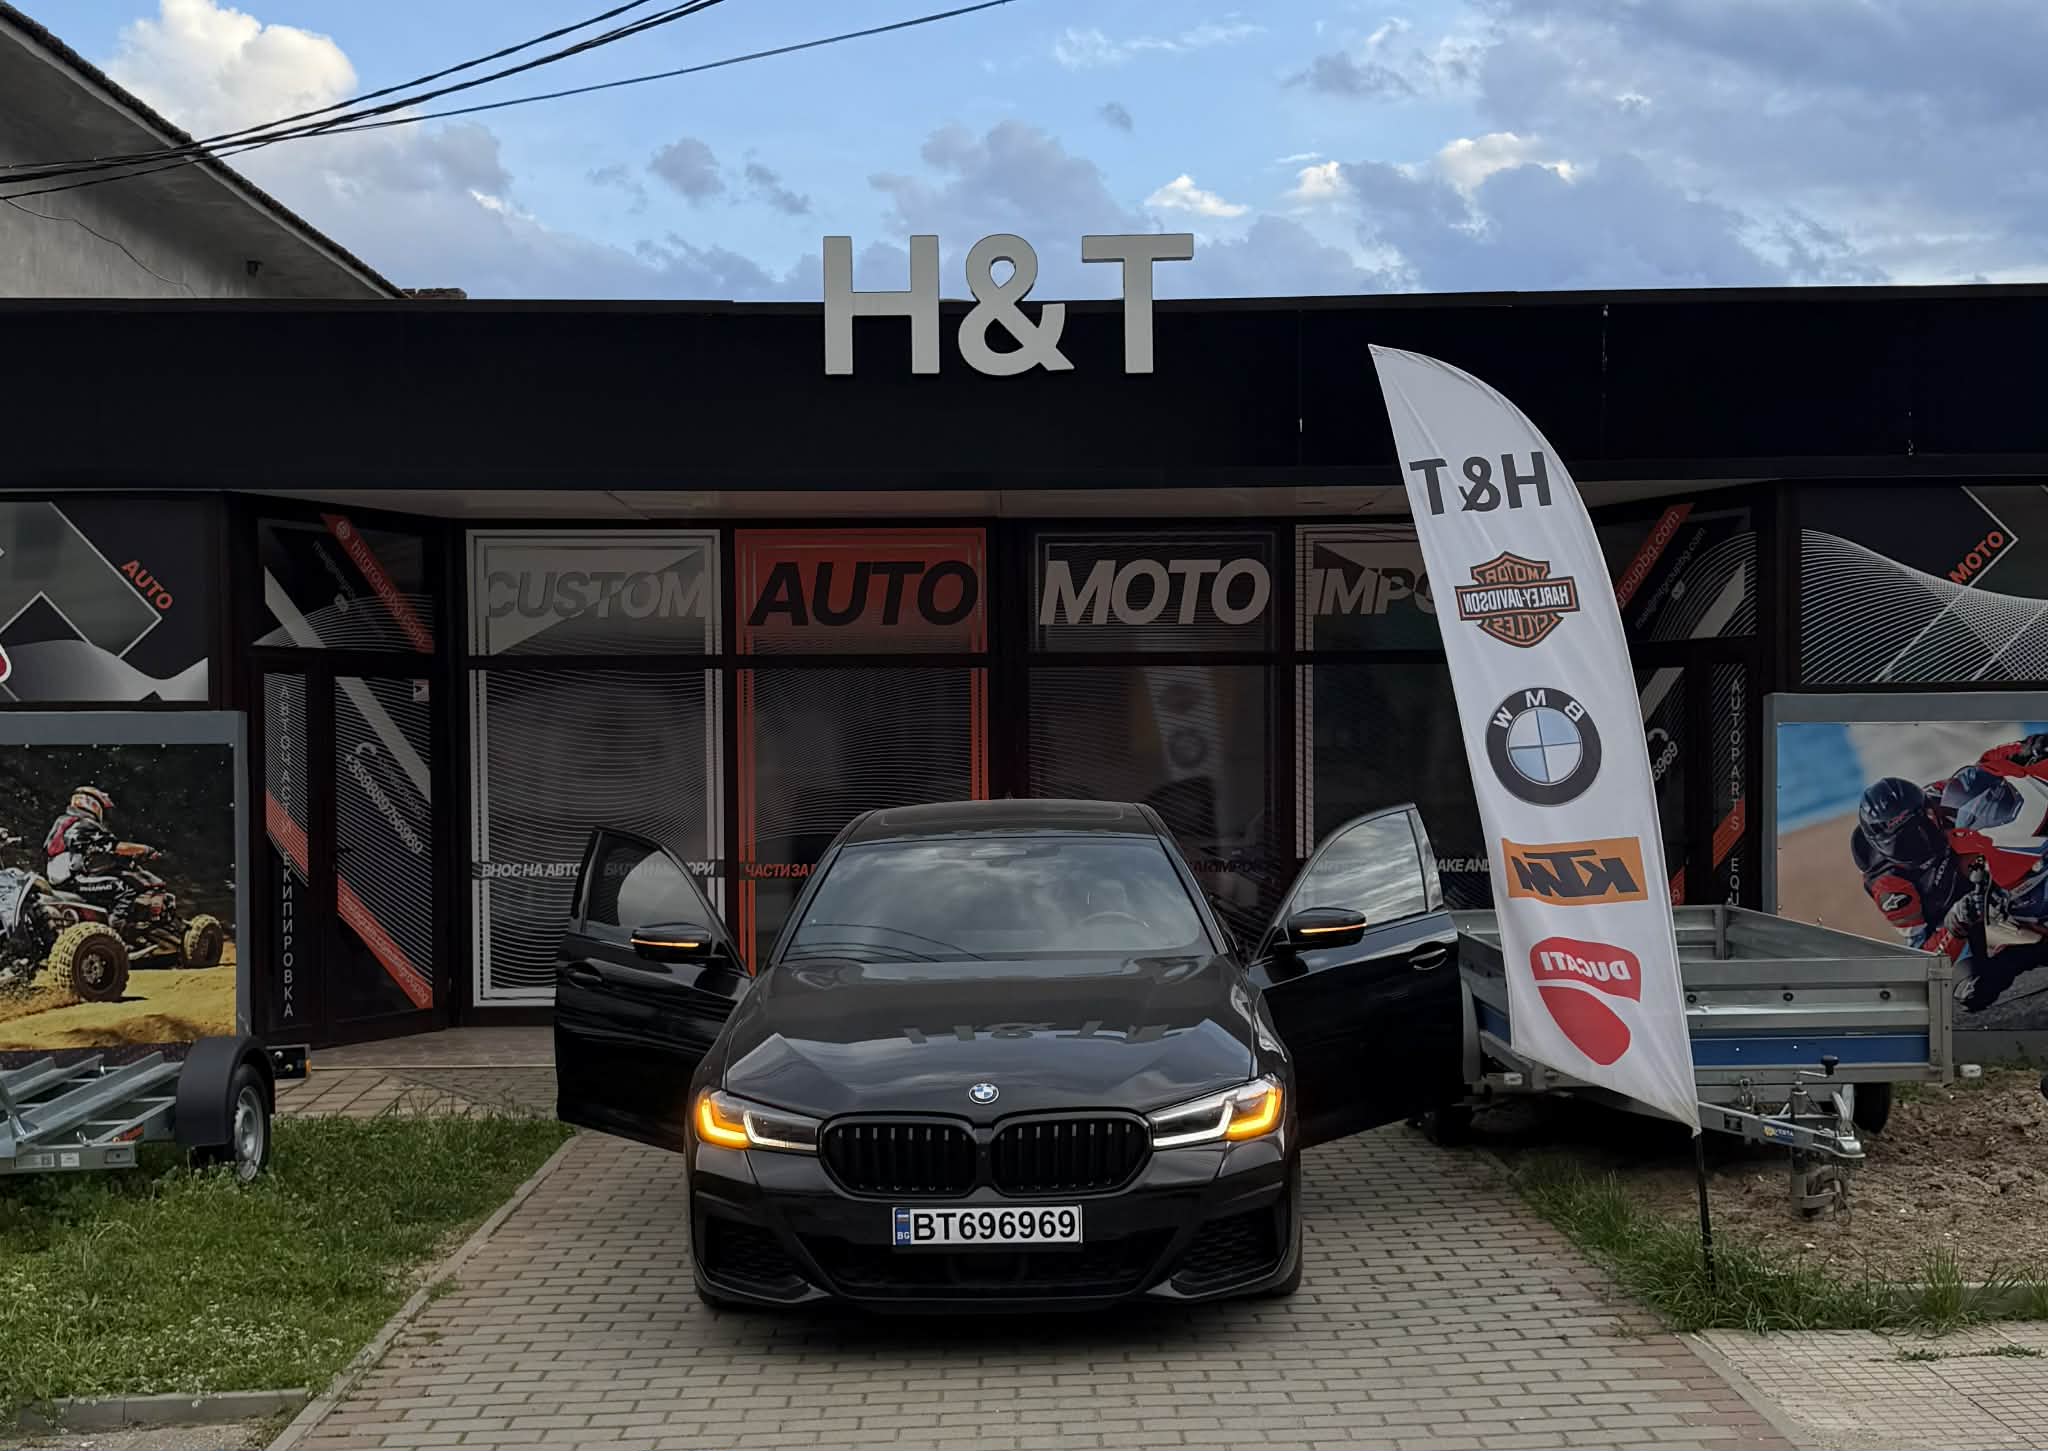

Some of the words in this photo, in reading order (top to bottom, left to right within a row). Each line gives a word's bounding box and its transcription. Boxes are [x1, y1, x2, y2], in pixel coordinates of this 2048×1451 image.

[823, 233, 1193, 376] H&T
[1944, 530, 2006, 584] MOTO
[121, 558, 174, 611] AUTO
[486, 569, 707, 622] CUSTOM
[747, 560, 979, 627] AUTO
[1038, 557, 1271, 625] MOTO
[744, 863, 792, 878] ЧАСТИ
[1437, 858, 1465, 873] AKE
[897, 1231, 911, 1240] BG
[913, 1209, 1076, 1241] BT696969
